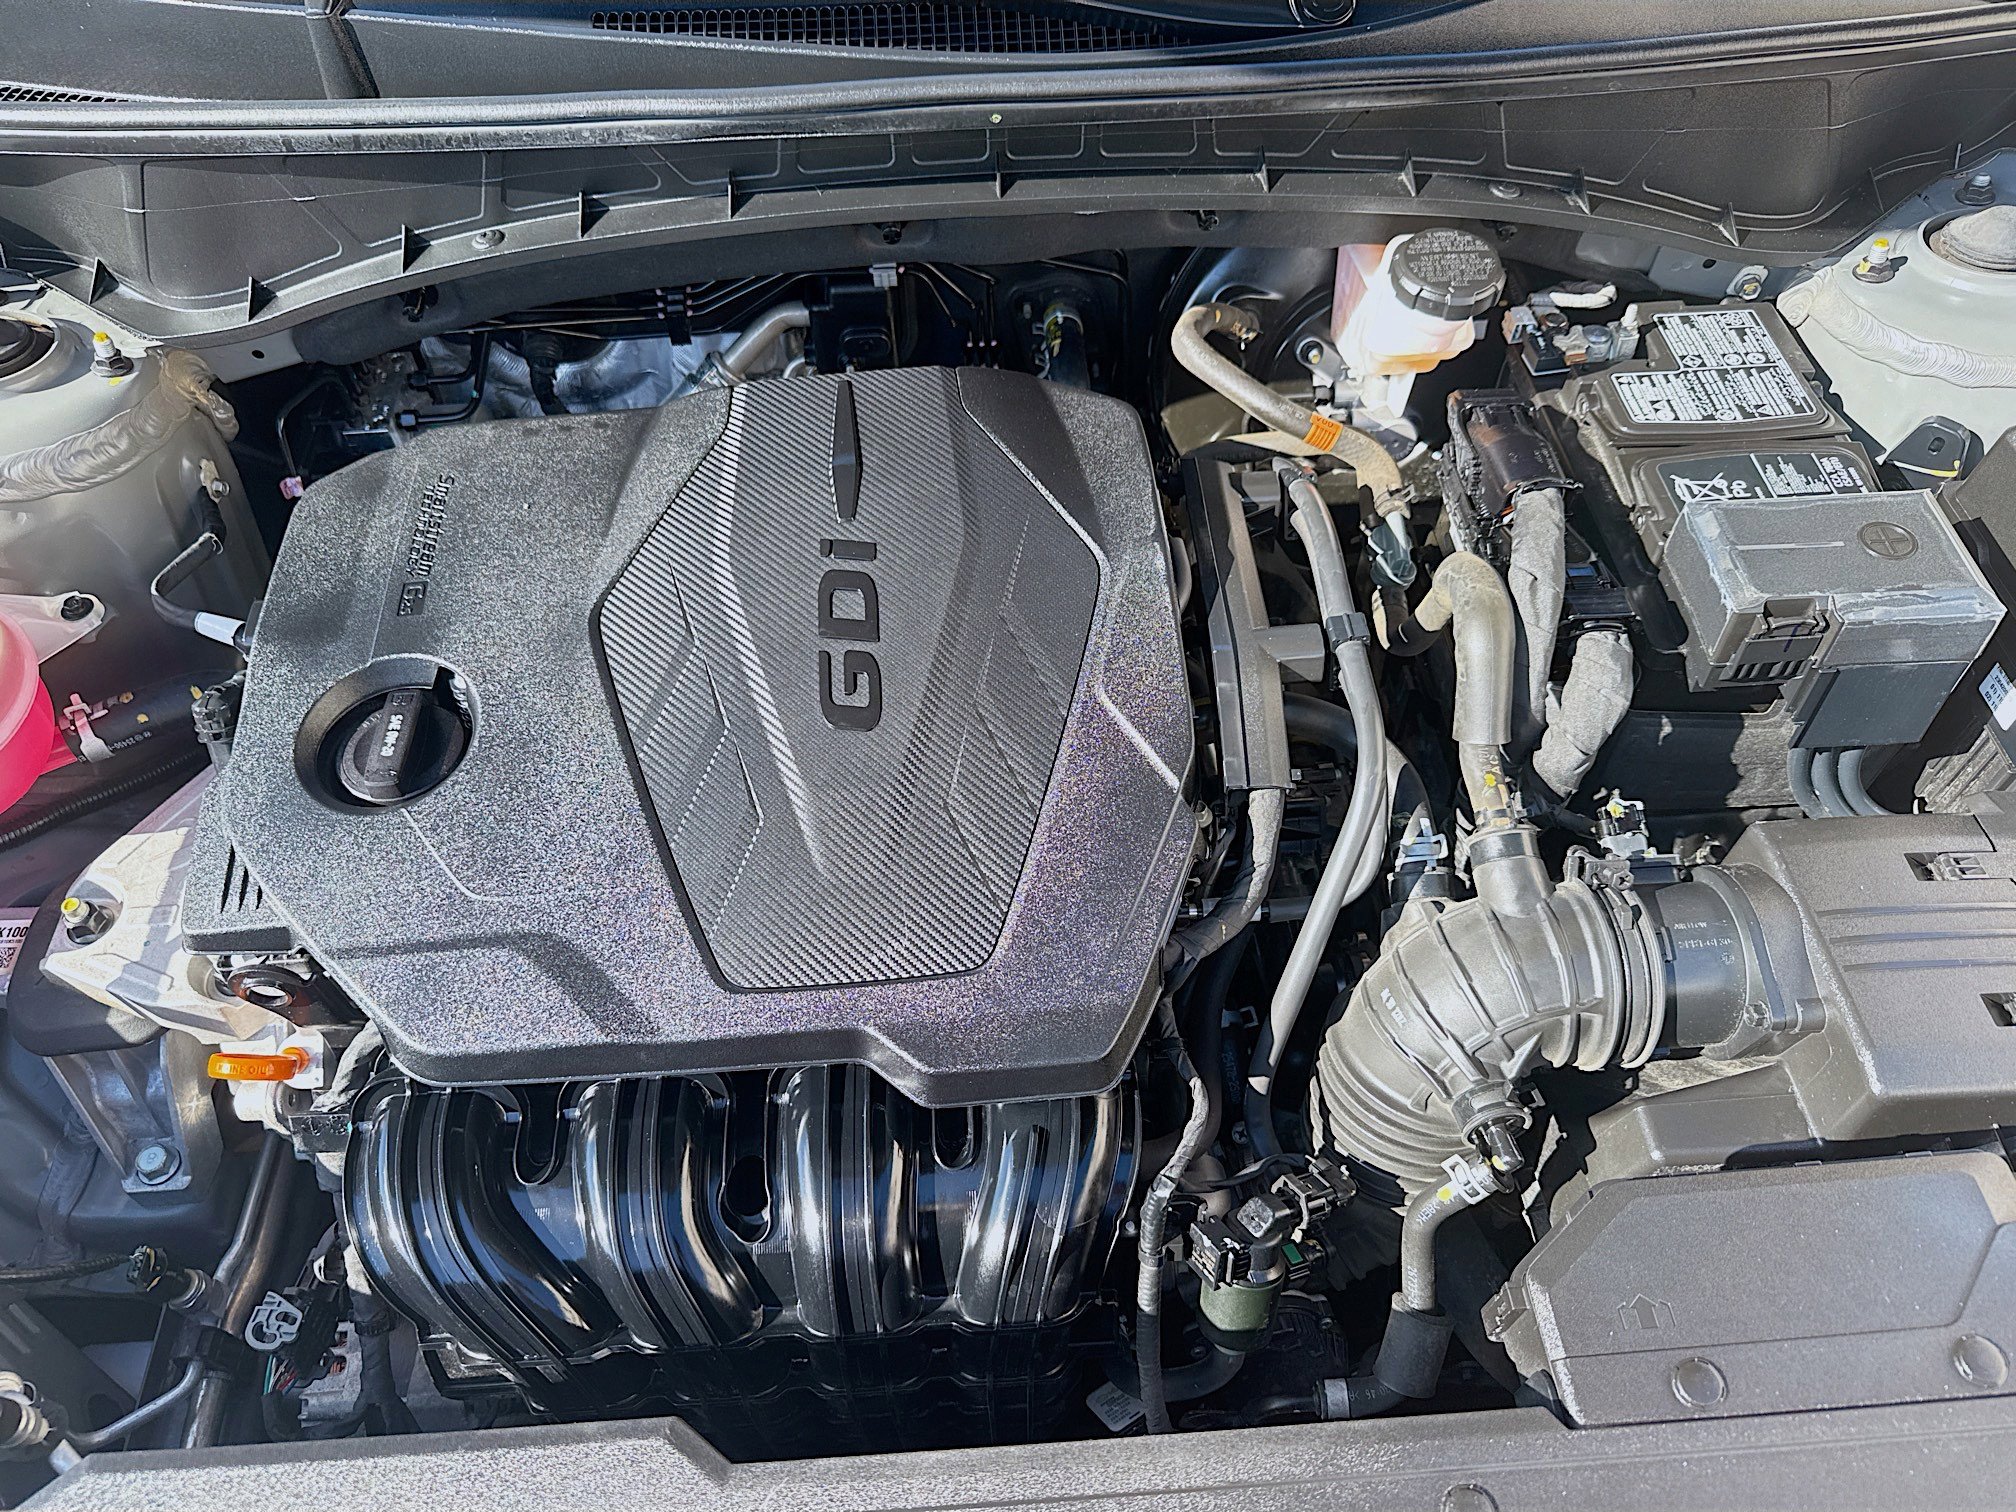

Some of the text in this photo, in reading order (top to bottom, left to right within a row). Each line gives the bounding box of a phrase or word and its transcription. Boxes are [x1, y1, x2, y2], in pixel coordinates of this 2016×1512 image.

[1730, 479, 1752, 498] Pb
[405, 484, 436, 578] TECHNOLOGY
[416, 473, 455, 577] Smartstream
[388, 714, 403, 731] SAE
